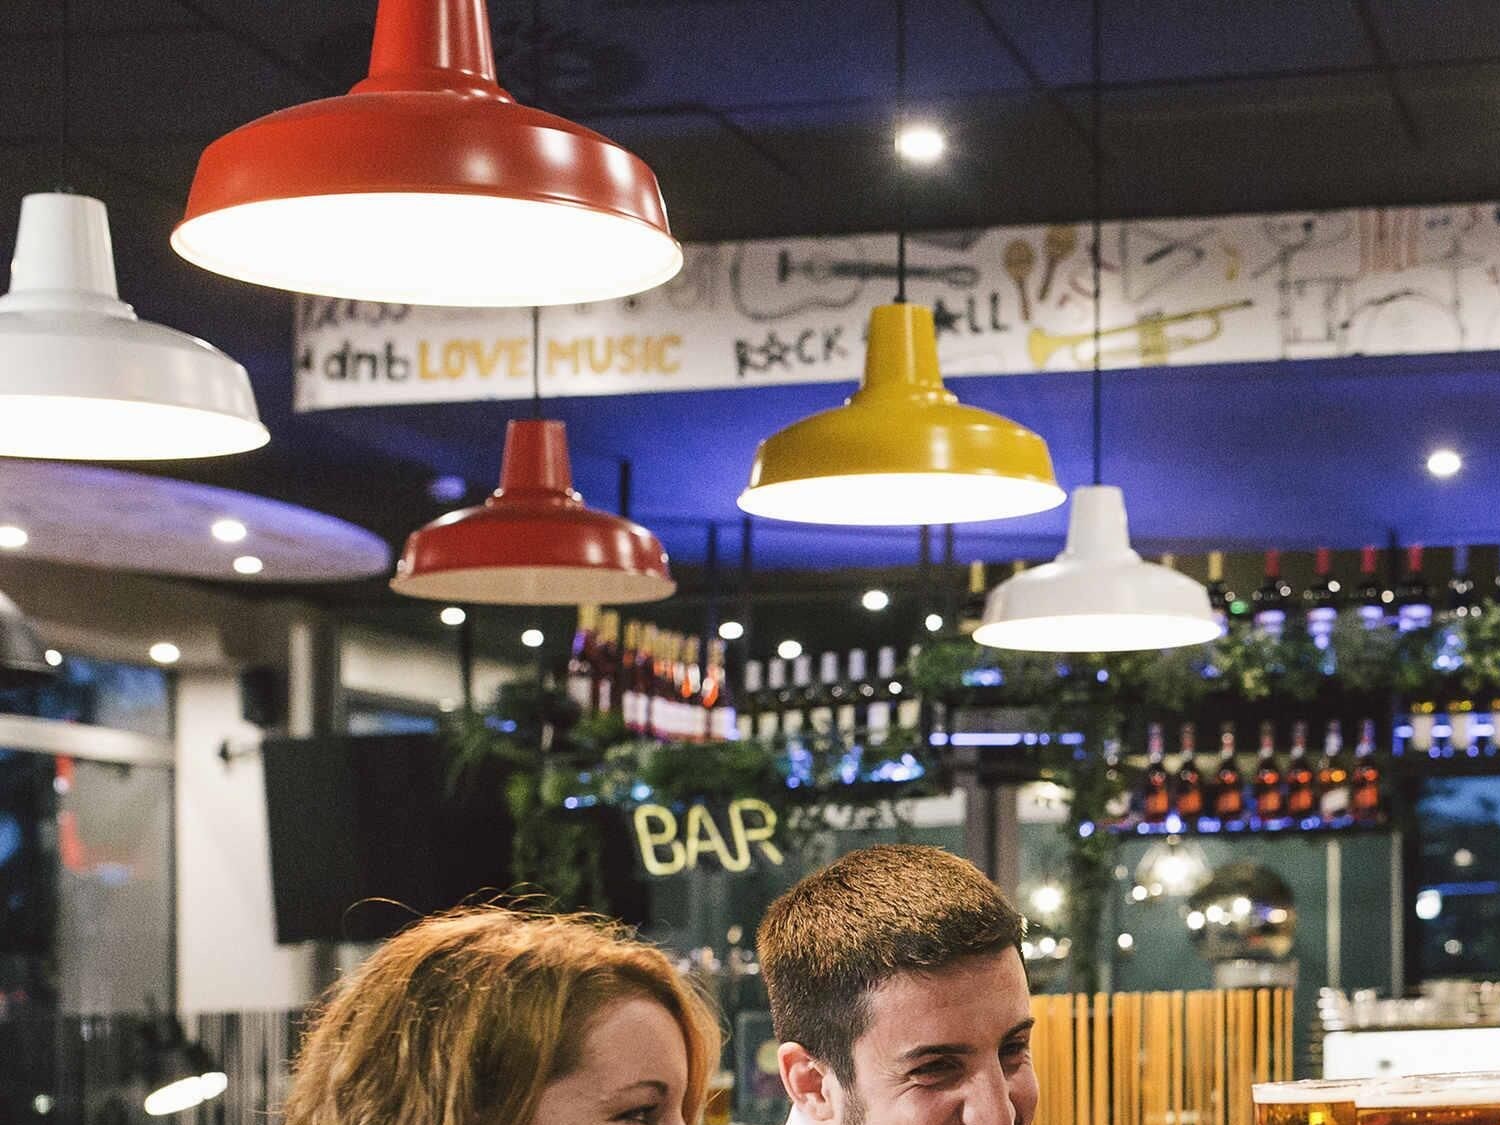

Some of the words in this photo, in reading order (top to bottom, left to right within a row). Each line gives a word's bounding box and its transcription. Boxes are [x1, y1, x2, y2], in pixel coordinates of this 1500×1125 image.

[417, 338, 528, 381] LOVE
[545, 333, 682, 376] MUSIC
[634, 799, 784, 876] BAR
